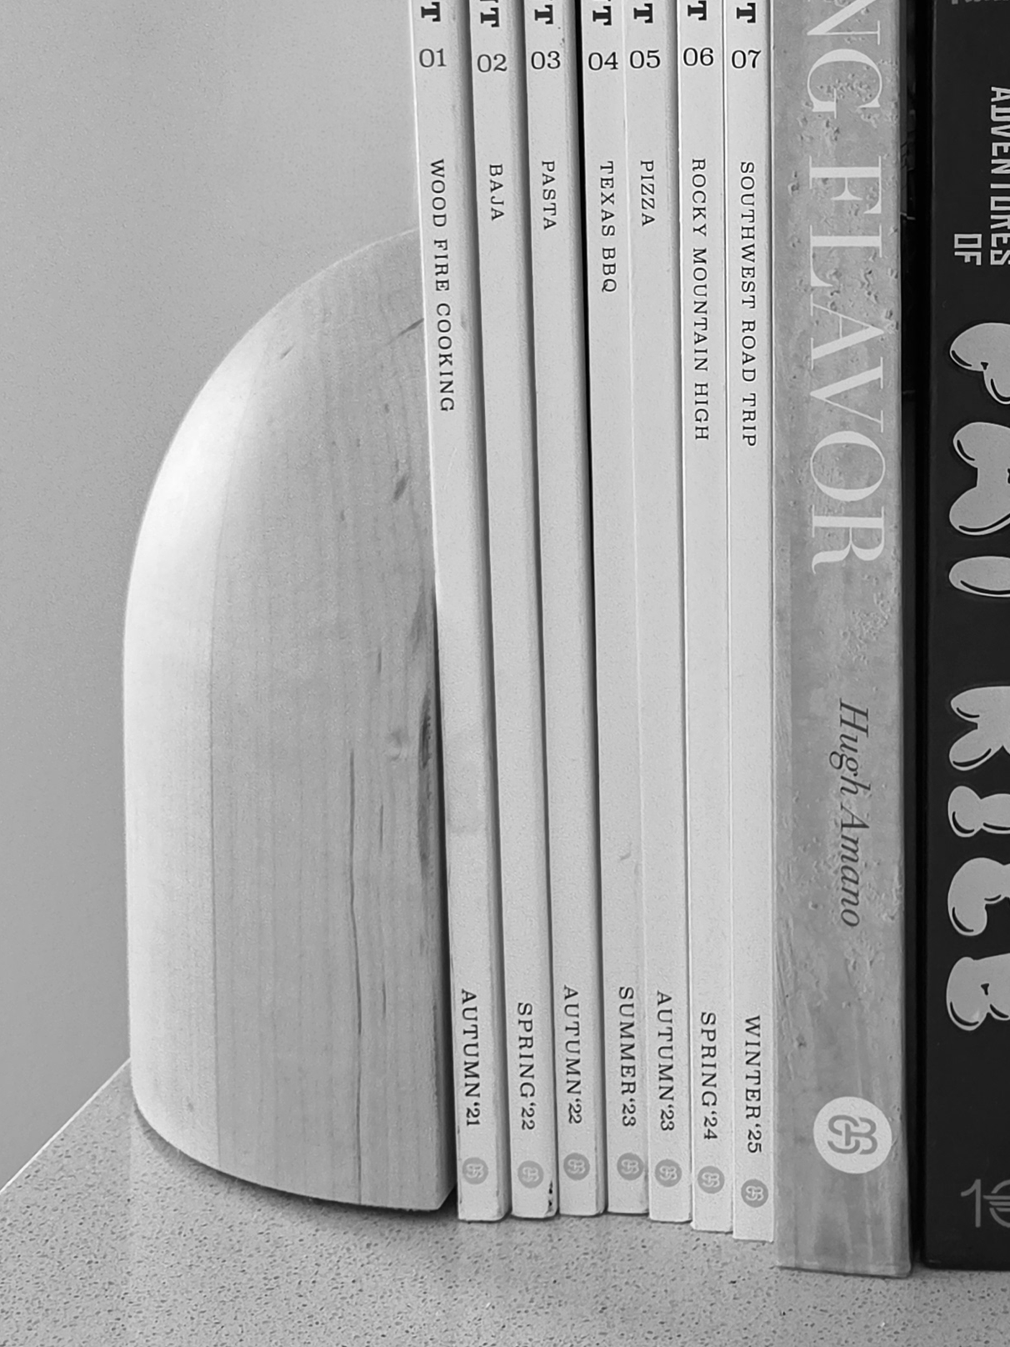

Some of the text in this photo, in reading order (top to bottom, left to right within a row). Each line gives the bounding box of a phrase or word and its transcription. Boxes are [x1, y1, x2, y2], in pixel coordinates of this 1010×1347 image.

[418, 48, 447, 68] 01
[477, 54, 508, 73] 02
[531, 51, 561, 70] 03
[588, 52, 619, 71] 04
[629, 49, 661, 69] 05
[682, 47, 714, 66] 06
[731, 49, 761, 69] 07
[489, 164, 505, 221] BAJA
[541, 160, 557, 231] PASTA
[640, 160, 656, 227] PIZZA
[599, 161, 617, 293] TEXAS BBQ
[954, 233, 982, 266] OF
[430, 159, 455, 412] WOOD FIRE COOKING
[691, 159, 709, 441] ROCKY MOUNTAIN HIGH
[740, 161, 757, 447] SOUTHWEST ROAD TRIP
[809, 155, 886, 574] FLAVOR
[829, 697, 871, 928] Hugh Amano
